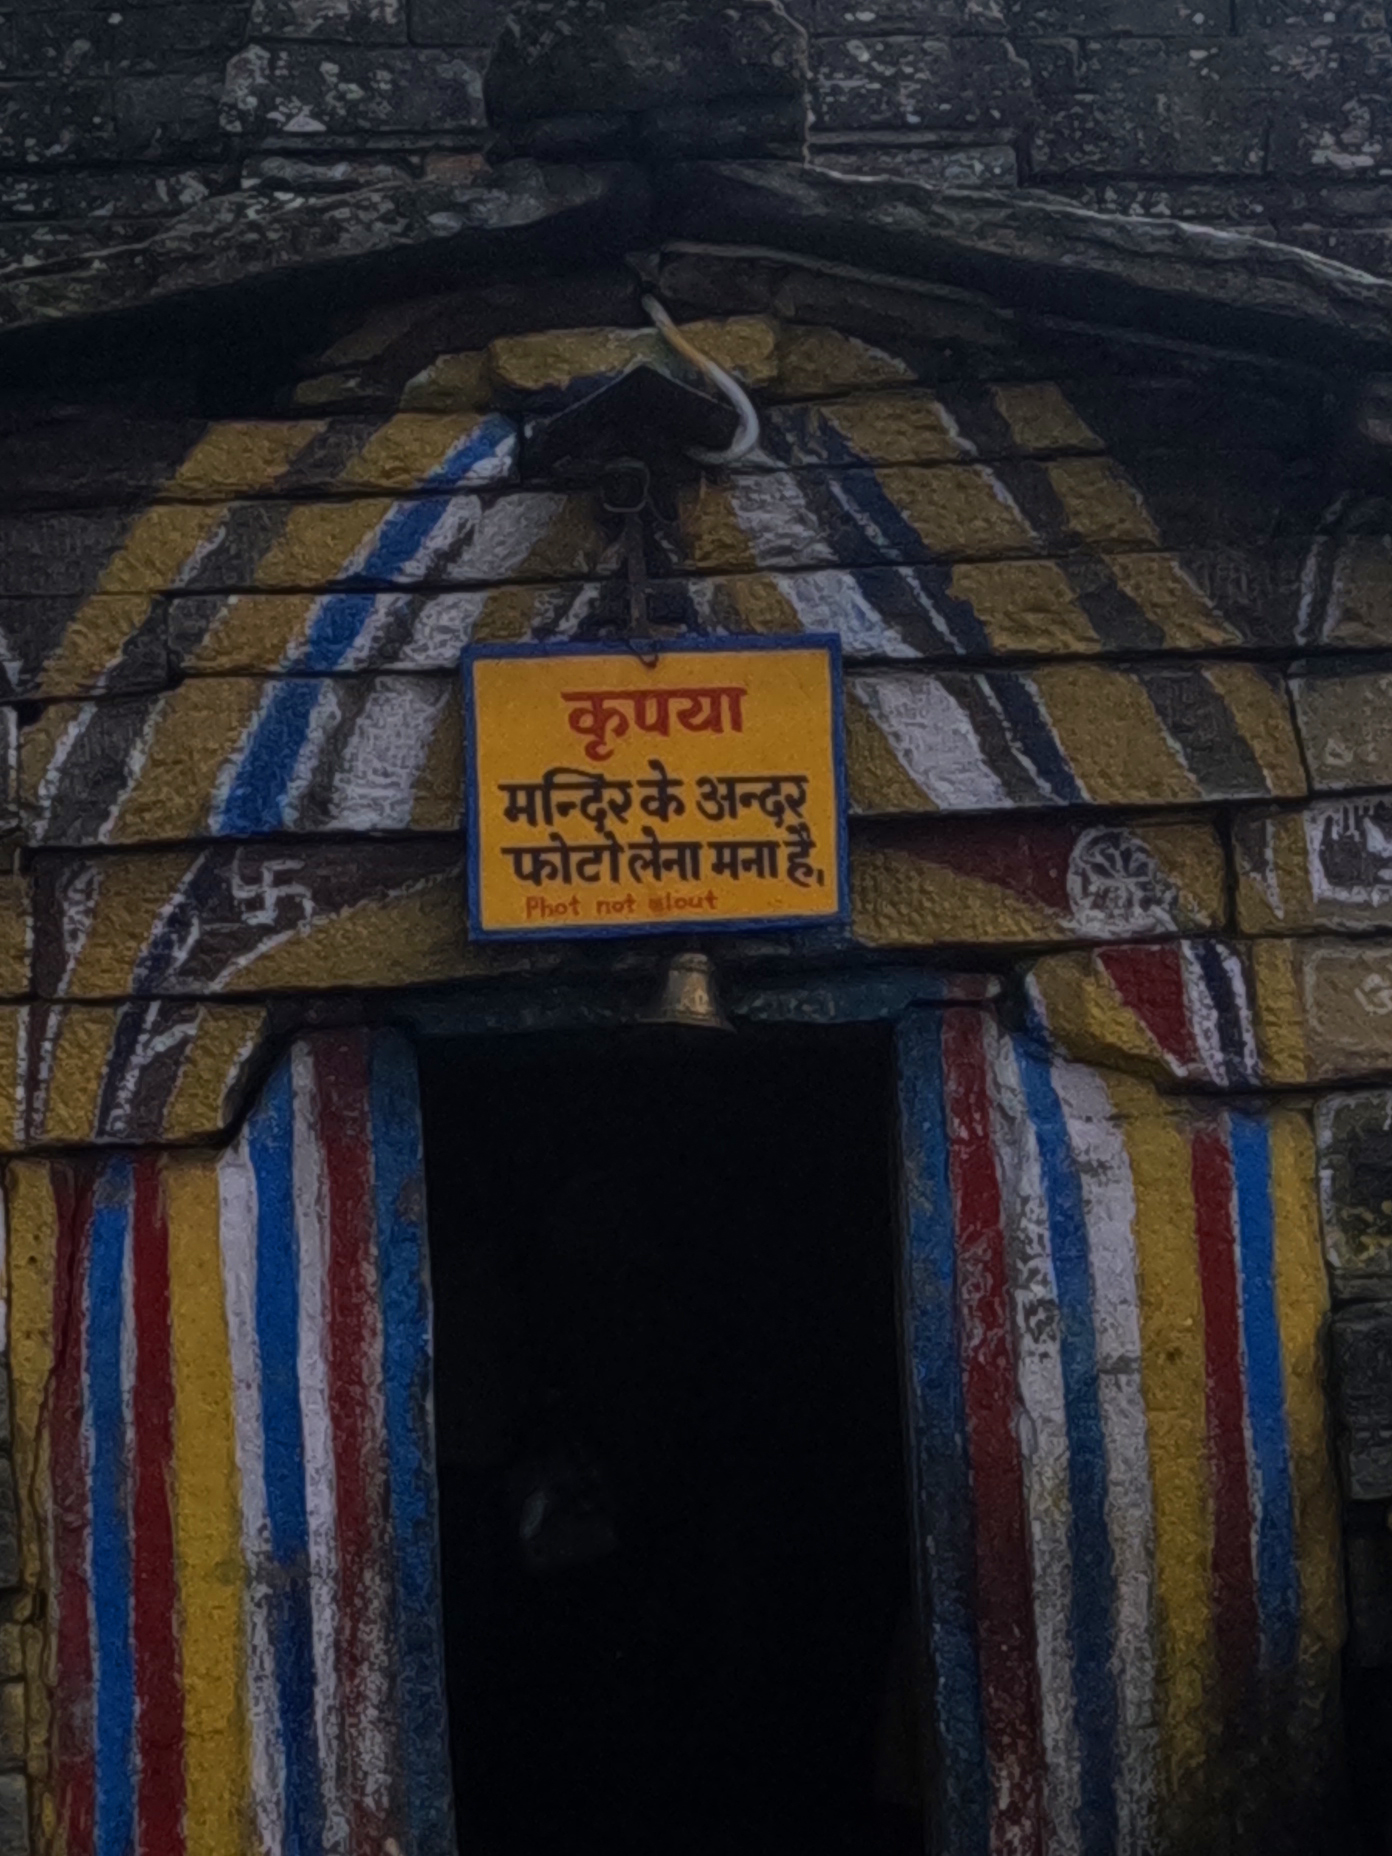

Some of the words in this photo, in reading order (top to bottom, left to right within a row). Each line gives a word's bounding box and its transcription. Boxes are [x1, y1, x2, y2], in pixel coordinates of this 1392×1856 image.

[561, 687, 747, 761] कृपया
[498, 766, 633, 833] मन्दिर
[636, 759, 685, 823] के
[694, 774, 809, 828] अन्दर
[501, 829, 625, 886] फोटो
[627, 825, 701, 883] लेना
[707, 839, 780, 882] मना
[525, 894, 581, 919] Phot
[595, 893, 637, 915] not
